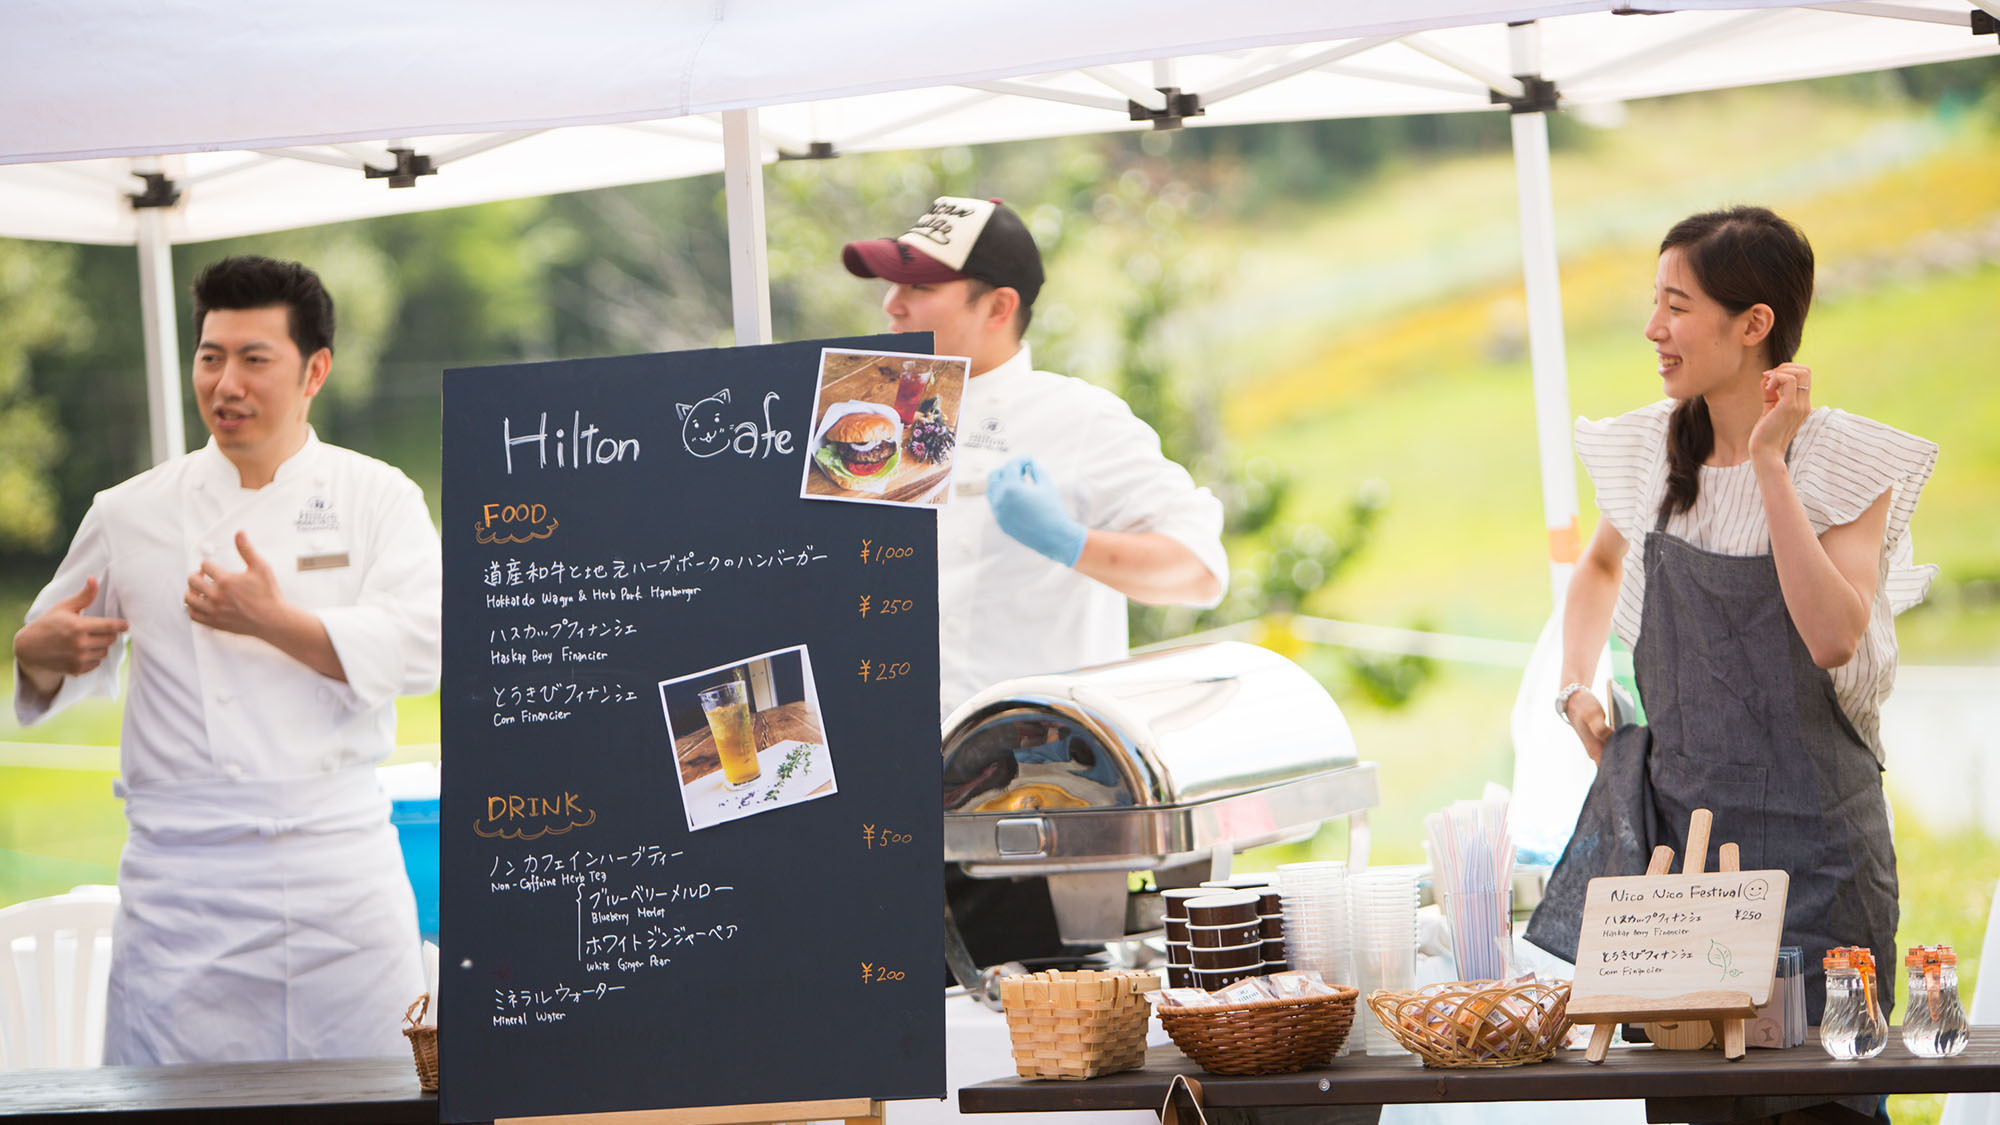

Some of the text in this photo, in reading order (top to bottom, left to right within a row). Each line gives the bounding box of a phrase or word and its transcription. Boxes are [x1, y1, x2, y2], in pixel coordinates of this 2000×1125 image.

[503, 410, 640, 474] Hilton
[483, 503, 548, 527] FOOD
[486, 593, 535, 608] Hokkaido
[578, 589, 587, 601] &
[593, 588, 616, 600] Herb
[621, 586, 643, 600] Pork
[650, 585, 701, 602] Hamburger
[490, 618, 637, 643] ハスカップフィナンシェ
[490, 648, 527, 665] Haskap
[562, 646, 608, 662] Financier
[493, 682, 637, 708] とうきびフィナンシェ
[493, 709, 571, 727] Corn Financier
[487, 792, 583, 822] DRINK
[561, 873, 585, 886] Herb
[589, 871, 607, 882] Tea
[589, 883, 734, 910] ブルーベリーメルロー
[1610, 883, 1743, 902] Nico Nico Festival
[591, 907, 666, 926] Blueberry Merlot
[1604, 911, 1703, 926] ハスカップフィナンシェ
[1735, 908, 1763, 921] ¥250
[586, 925, 738, 955] ホワイトジンジャーペア
[1654, 927, 1690, 937] Financier
[617, 957, 645, 972] Ginger
[650, 954, 671, 967] Pear
[1602, 948, 1694, 963] とうきびフィナンシェ
[495, 982, 626, 1011] ミネラルウォーター
[492, 1011, 566, 1027] Mineral Water
